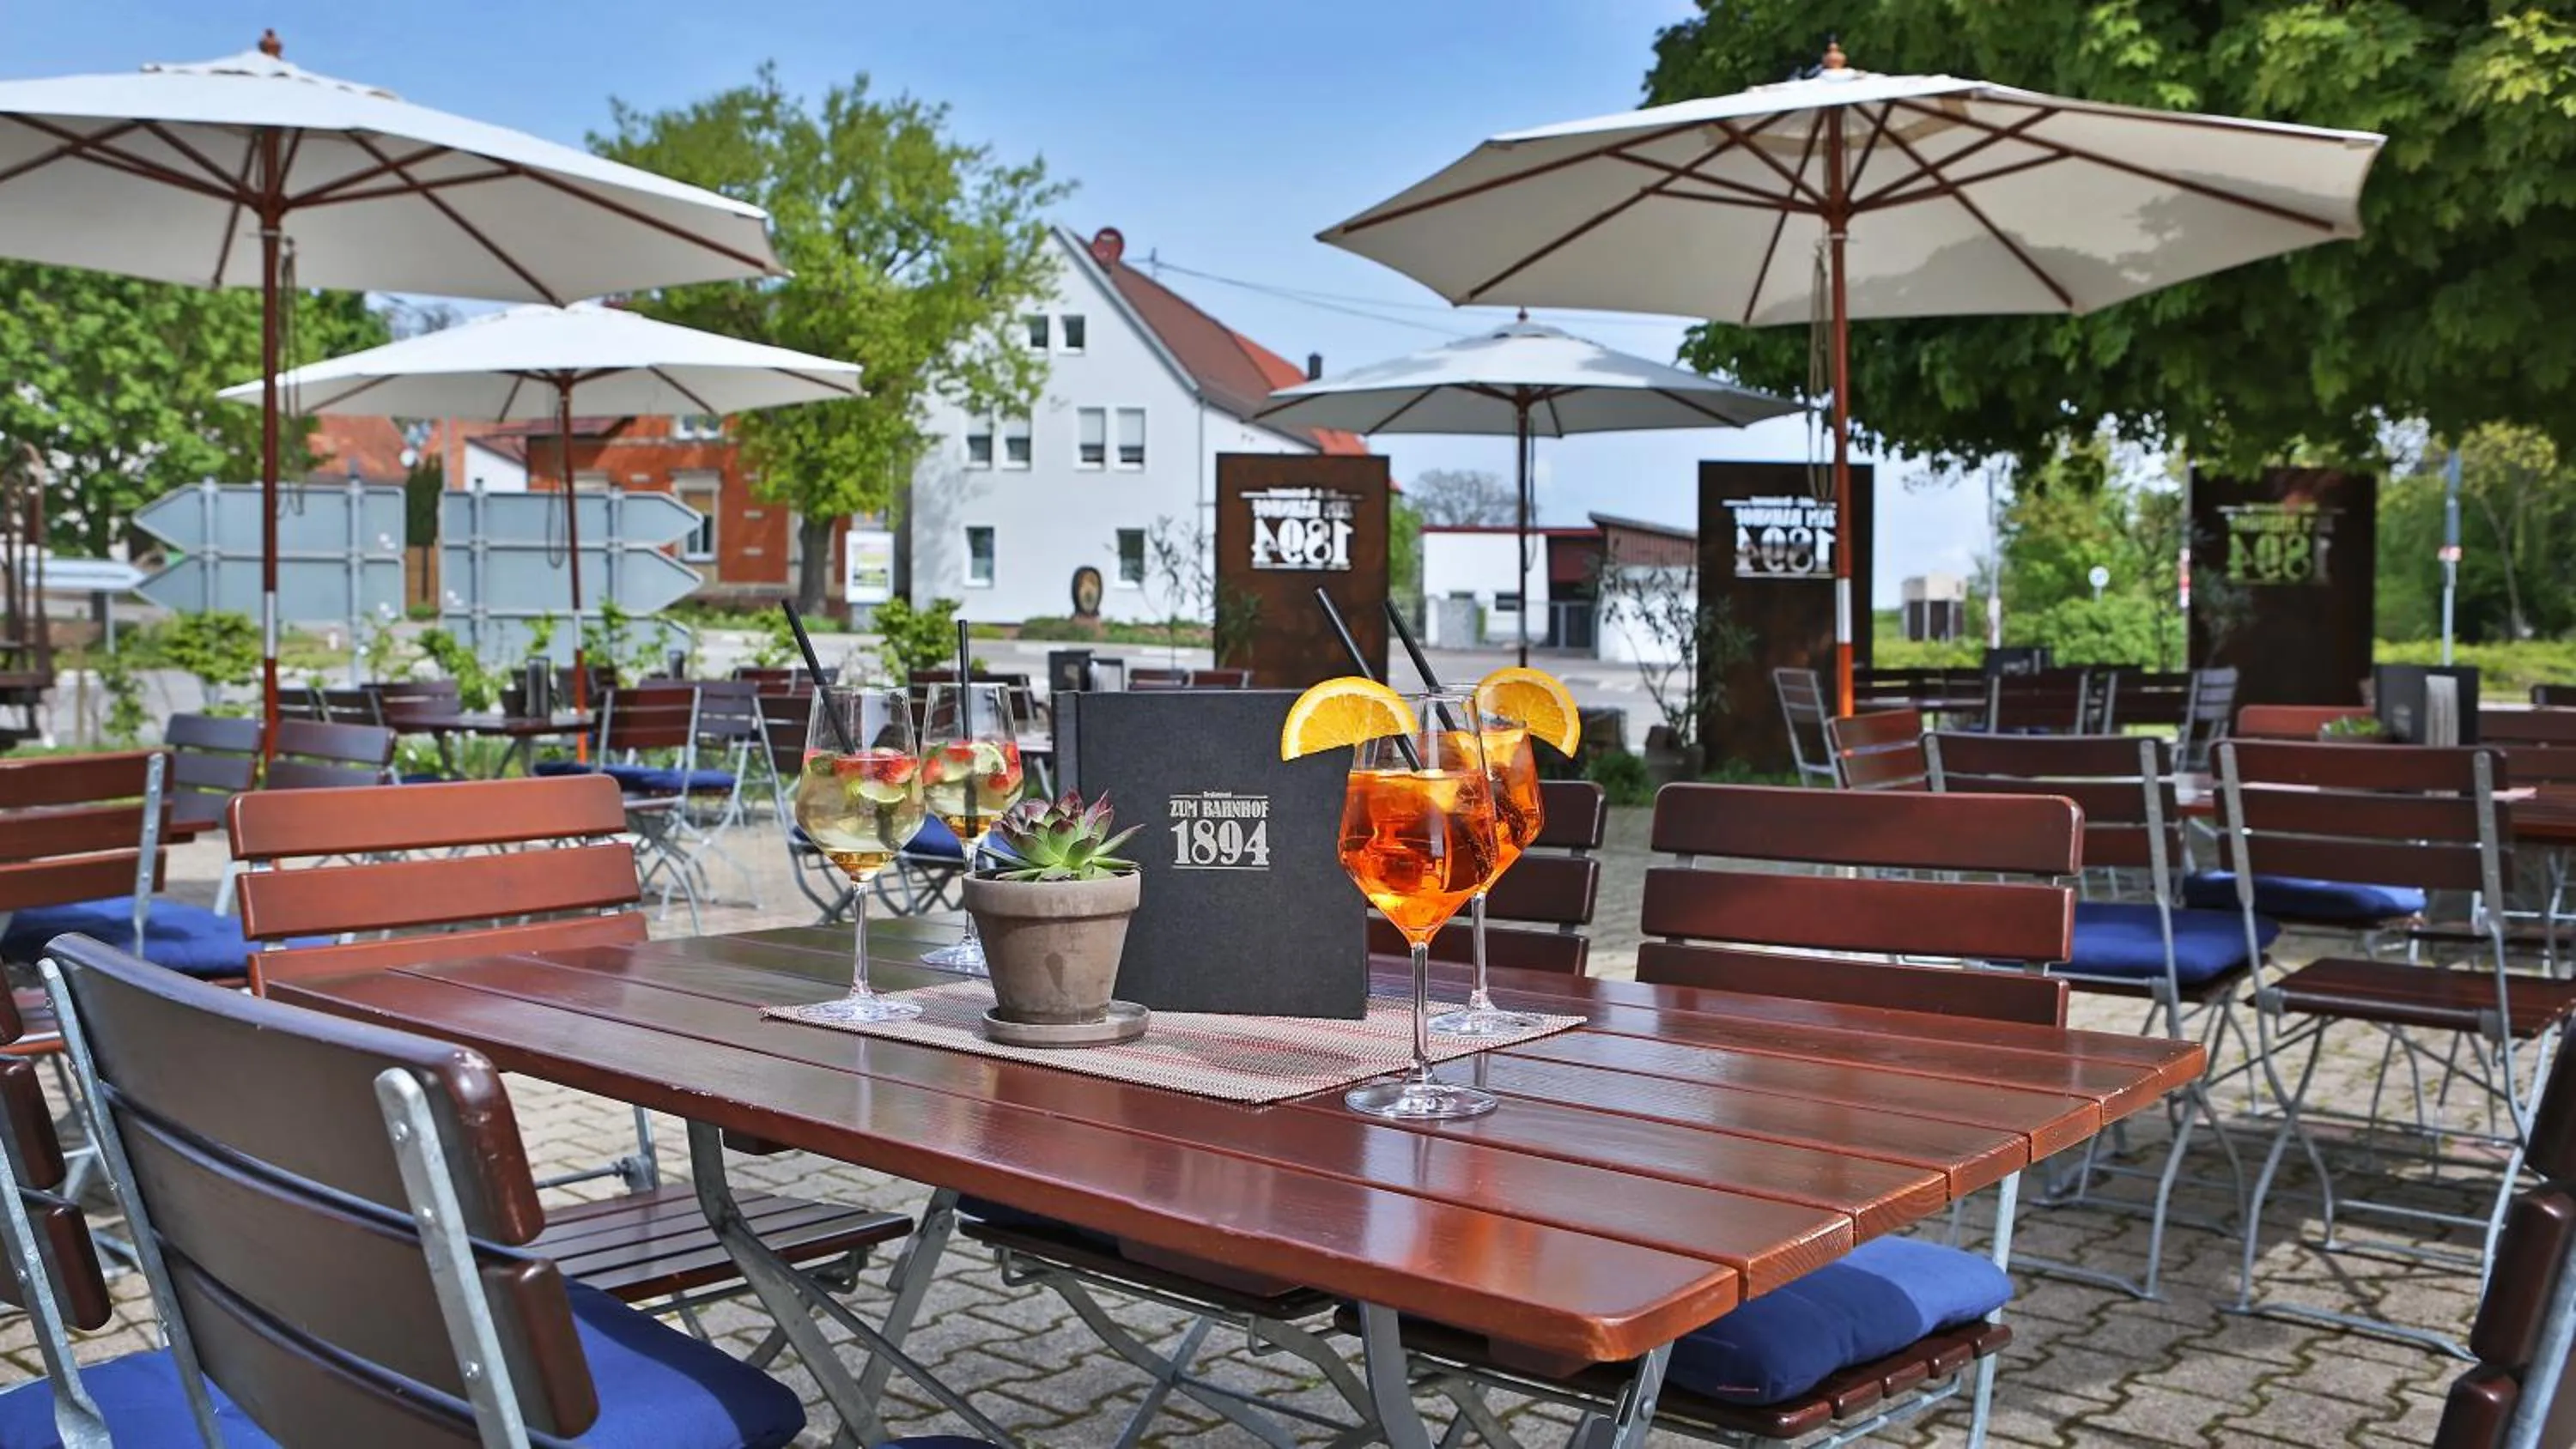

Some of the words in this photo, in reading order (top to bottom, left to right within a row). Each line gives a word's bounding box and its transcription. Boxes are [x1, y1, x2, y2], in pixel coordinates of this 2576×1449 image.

[1169, 799, 1198, 818] ZUM
[1202, 799, 1269, 818] BAHNHOF
[1170, 819, 1270, 866] 1894
